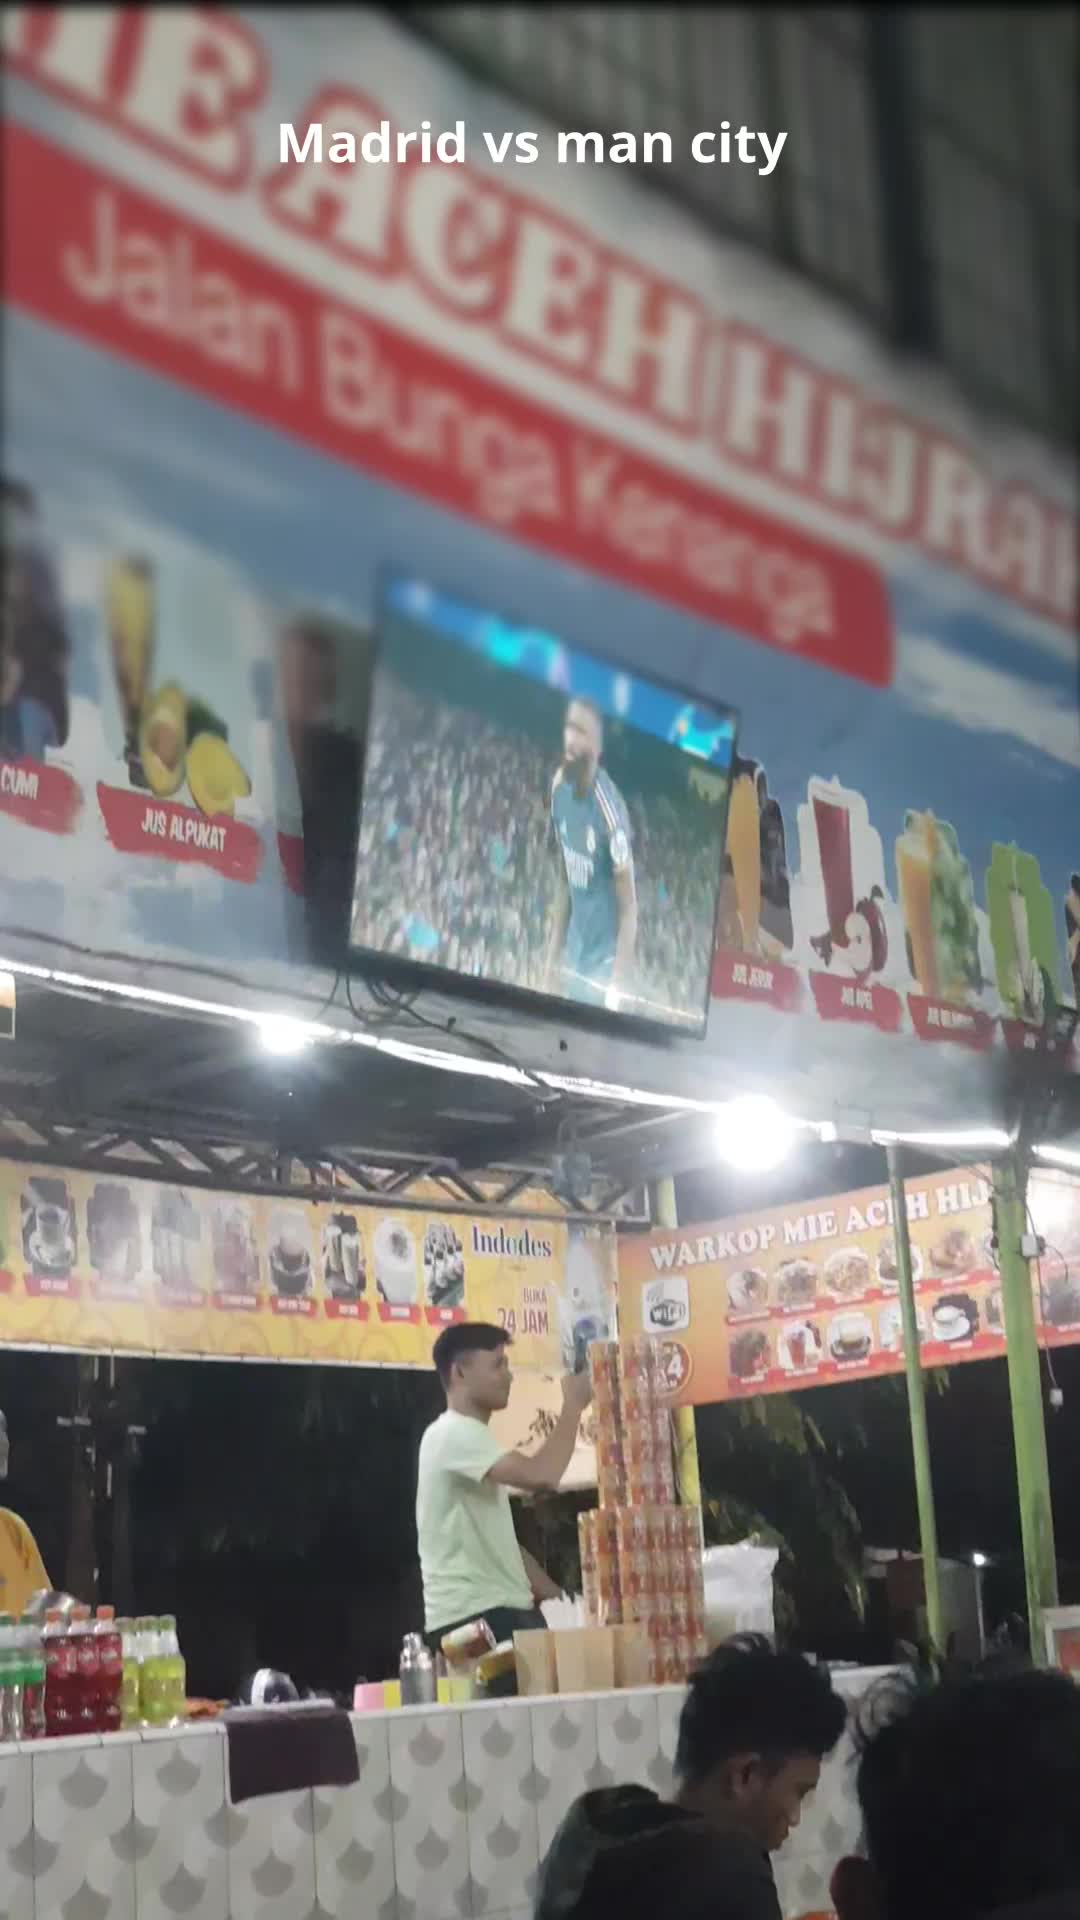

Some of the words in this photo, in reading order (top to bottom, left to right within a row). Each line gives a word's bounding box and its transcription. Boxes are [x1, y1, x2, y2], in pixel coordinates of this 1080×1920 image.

[0, 8, 266, 190] IE
[262, 83, 704, 437] ACEH
[62, 194, 301, 392] Jalan
[319, 308, 558, 526] Bunga
[141, 807, 168, 837] JUS
[169, 813, 227, 853] ALPUKAT
[650, 1223, 777, 1270] WARKOP
[783, 1210, 838, 1245] MIE
[520, 1308, 550, 1335] JAM
